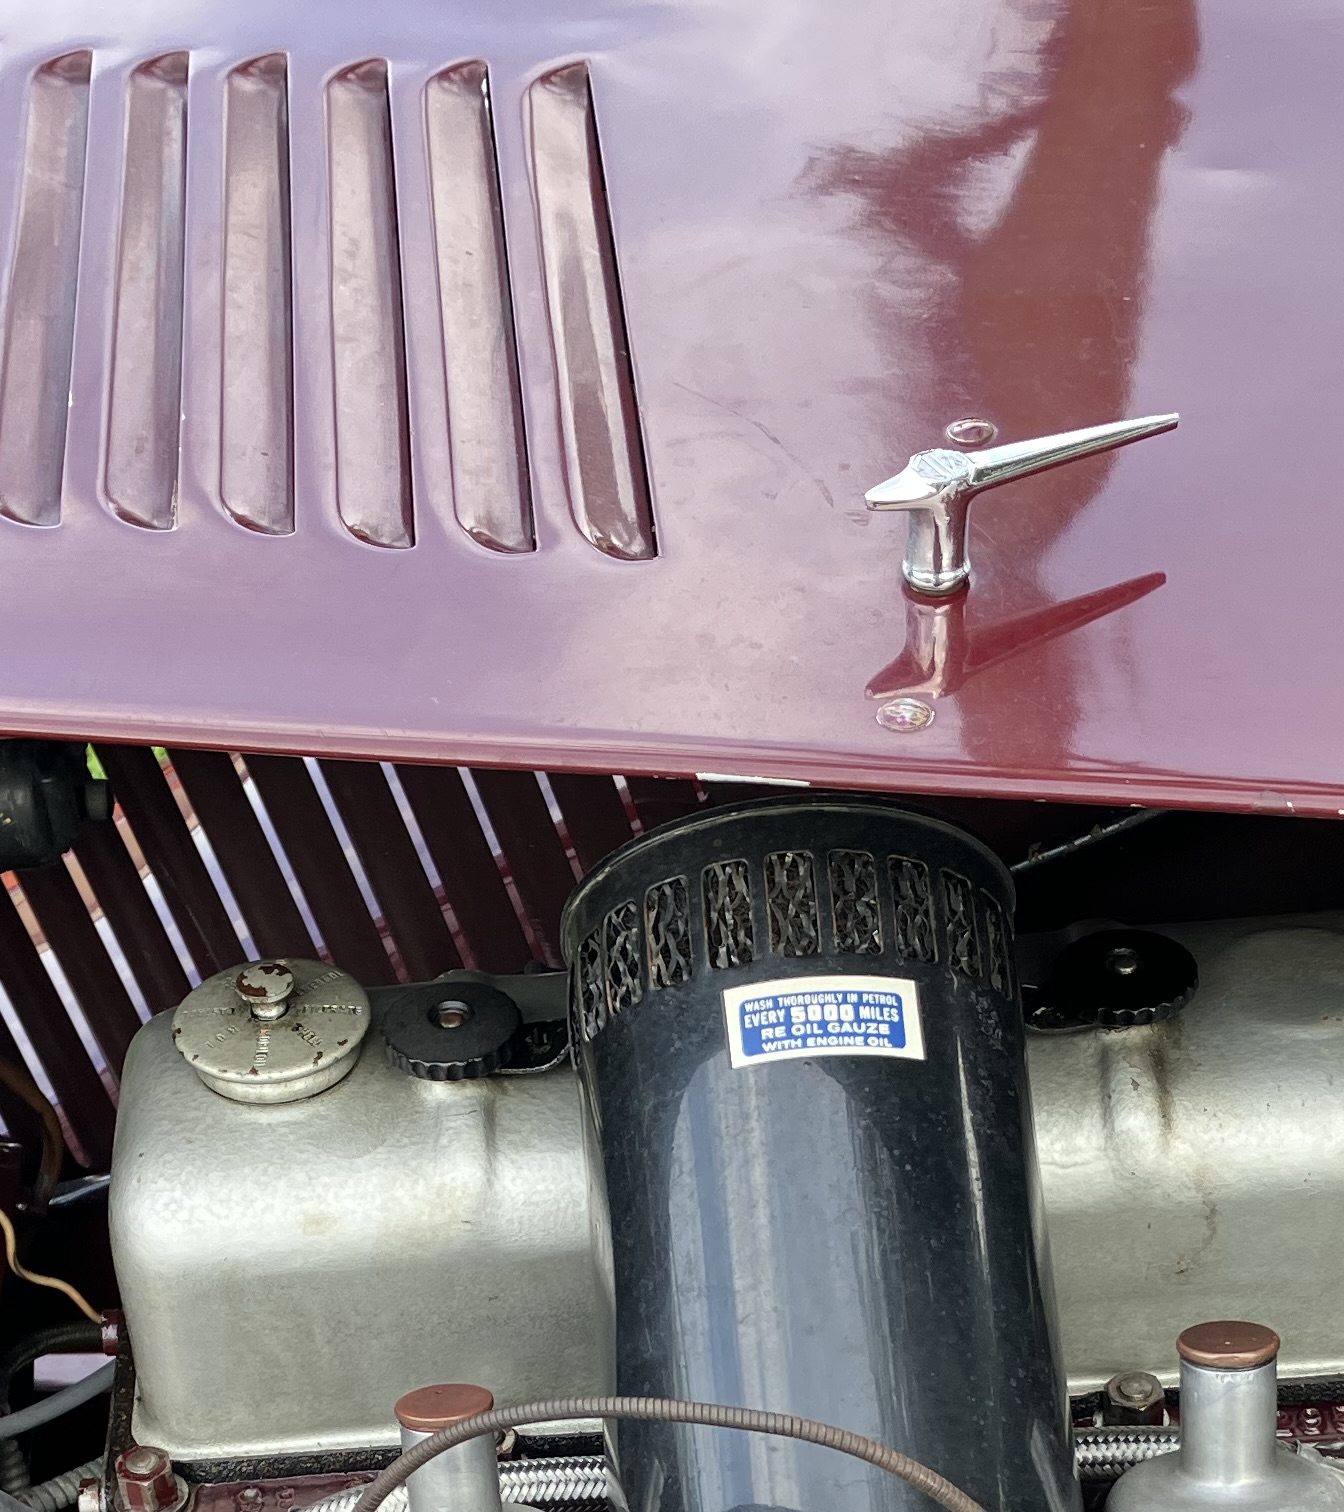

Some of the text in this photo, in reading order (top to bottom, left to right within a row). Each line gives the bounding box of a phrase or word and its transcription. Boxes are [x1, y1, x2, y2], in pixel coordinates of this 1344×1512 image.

[744, 993, 899, 1012] WASH THOROUGHLY IN PETROL
[744, 1004, 900, 1029] EVERY 5000 MILES
[760, 1022, 891, 1040] RE OIL GAUZE
[761, 1036, 893, 1052] WITH ENGINE OIL
